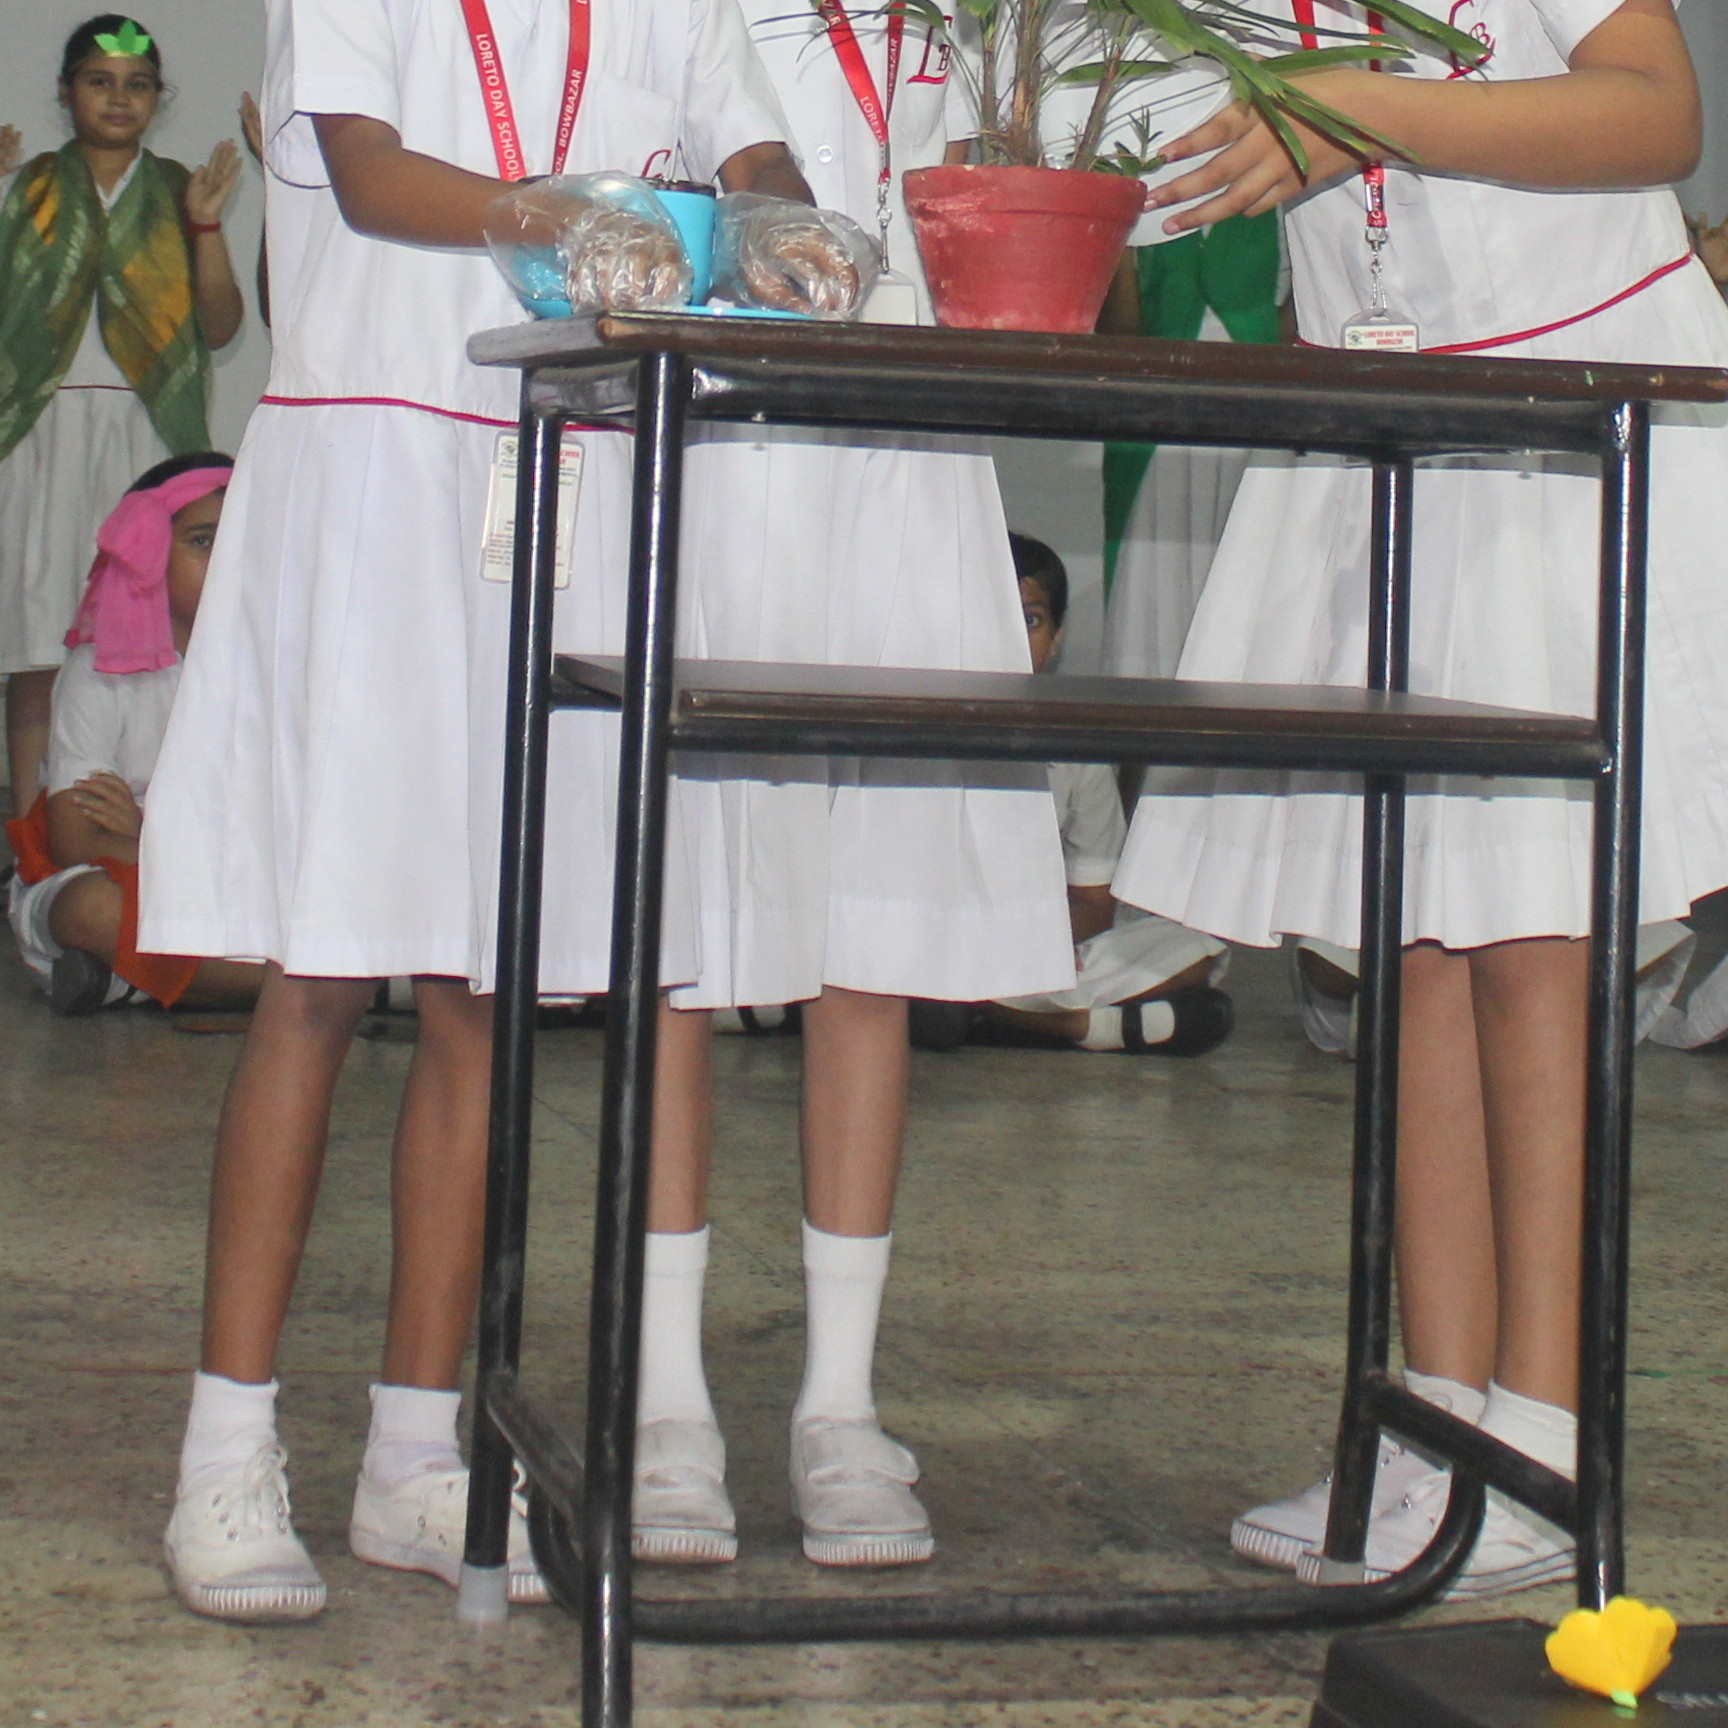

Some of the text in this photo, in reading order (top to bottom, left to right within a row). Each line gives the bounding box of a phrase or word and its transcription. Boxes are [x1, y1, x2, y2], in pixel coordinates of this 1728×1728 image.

[476, 33, 520, 179] LORETO DAY SCHOOL
[559, 69, 583, 149] BOWBAZAR
